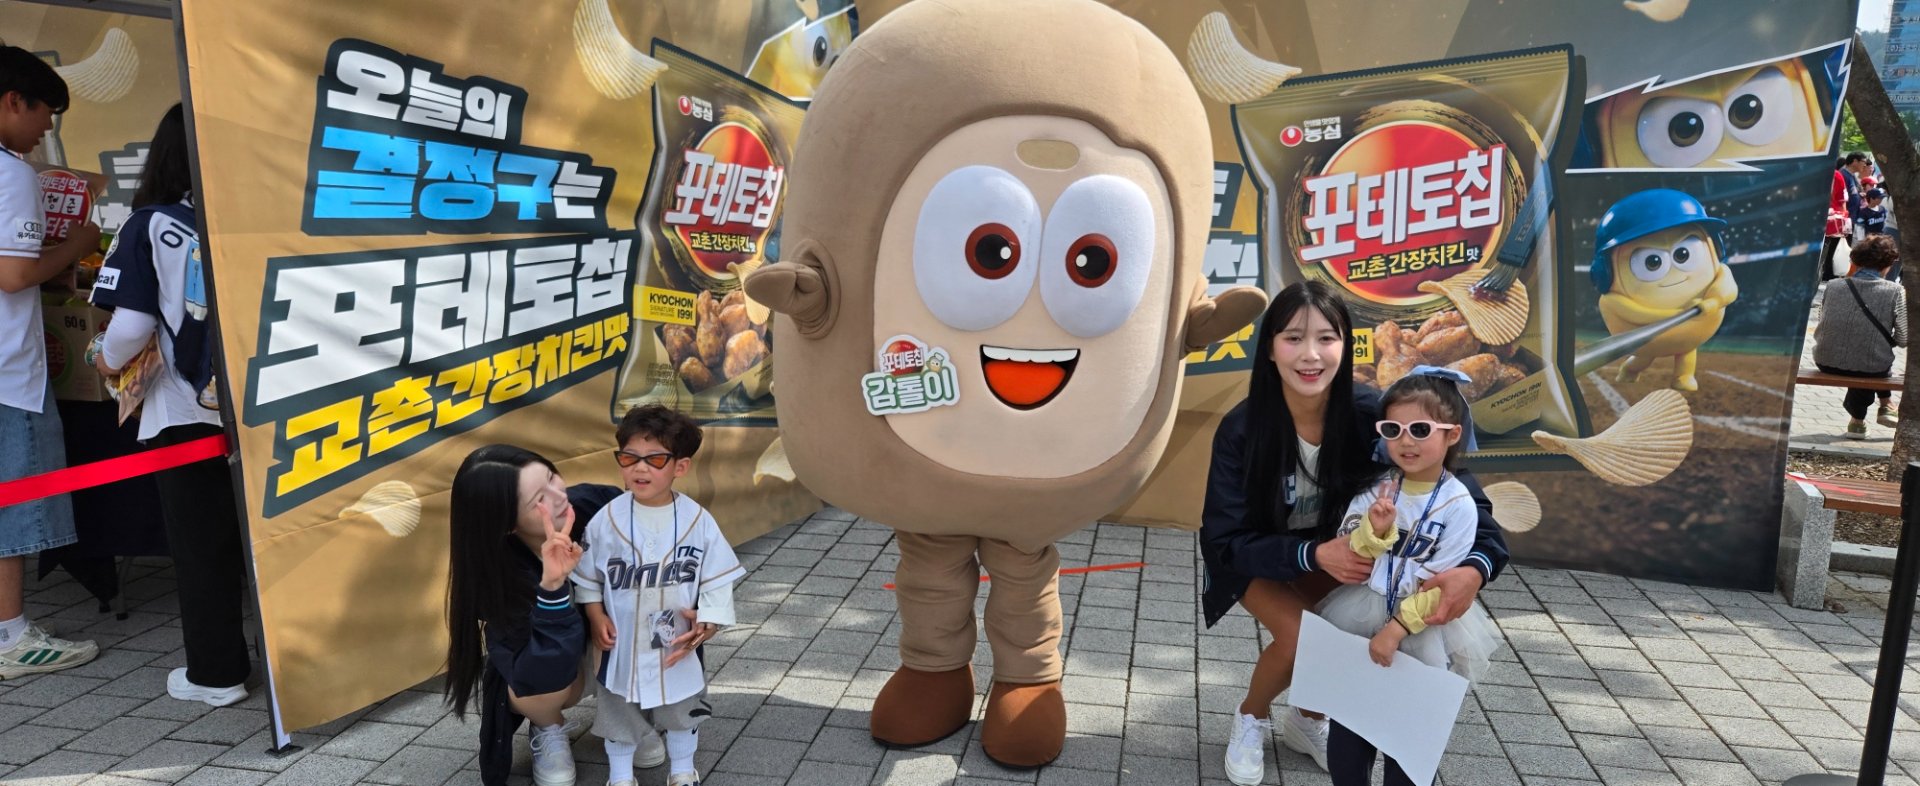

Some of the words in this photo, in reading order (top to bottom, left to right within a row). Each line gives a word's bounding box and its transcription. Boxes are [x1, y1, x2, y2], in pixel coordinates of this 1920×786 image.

[328, 51, 512, 139] 오늘의
[1304, 124, 1341, 142] 농심
[313, 126, 603, 221] 결정구는
[665, 150, 784, 228] 포테토칩
[1301, 146, 1504, 261] 포테토칩
[256, 238, 632, 405] 포테토칩
[650, 293, 693, 308] KYOCHON
[677, 309, 693, 320] 1991
[868, 368, 953, 408] 감돌이
[882, 347, 924, 373] 포테토칩
